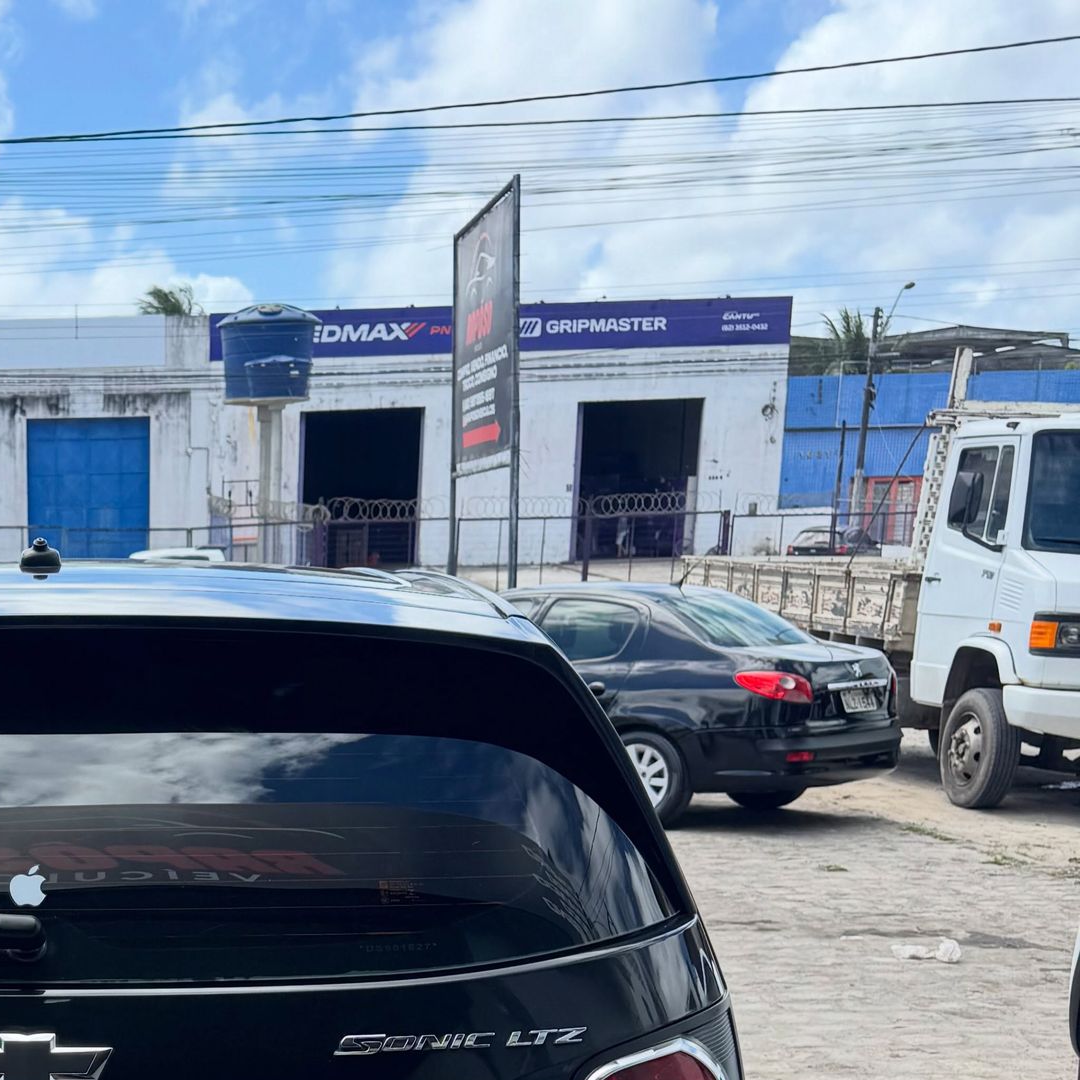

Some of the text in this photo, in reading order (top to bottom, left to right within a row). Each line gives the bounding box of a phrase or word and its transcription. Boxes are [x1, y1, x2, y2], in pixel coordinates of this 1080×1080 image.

[430, 325, 452, 335] PN
[546, 317, 667, 334] GRIPMASTER
[333, 1027, 587, 1056] SONIC LTZ
